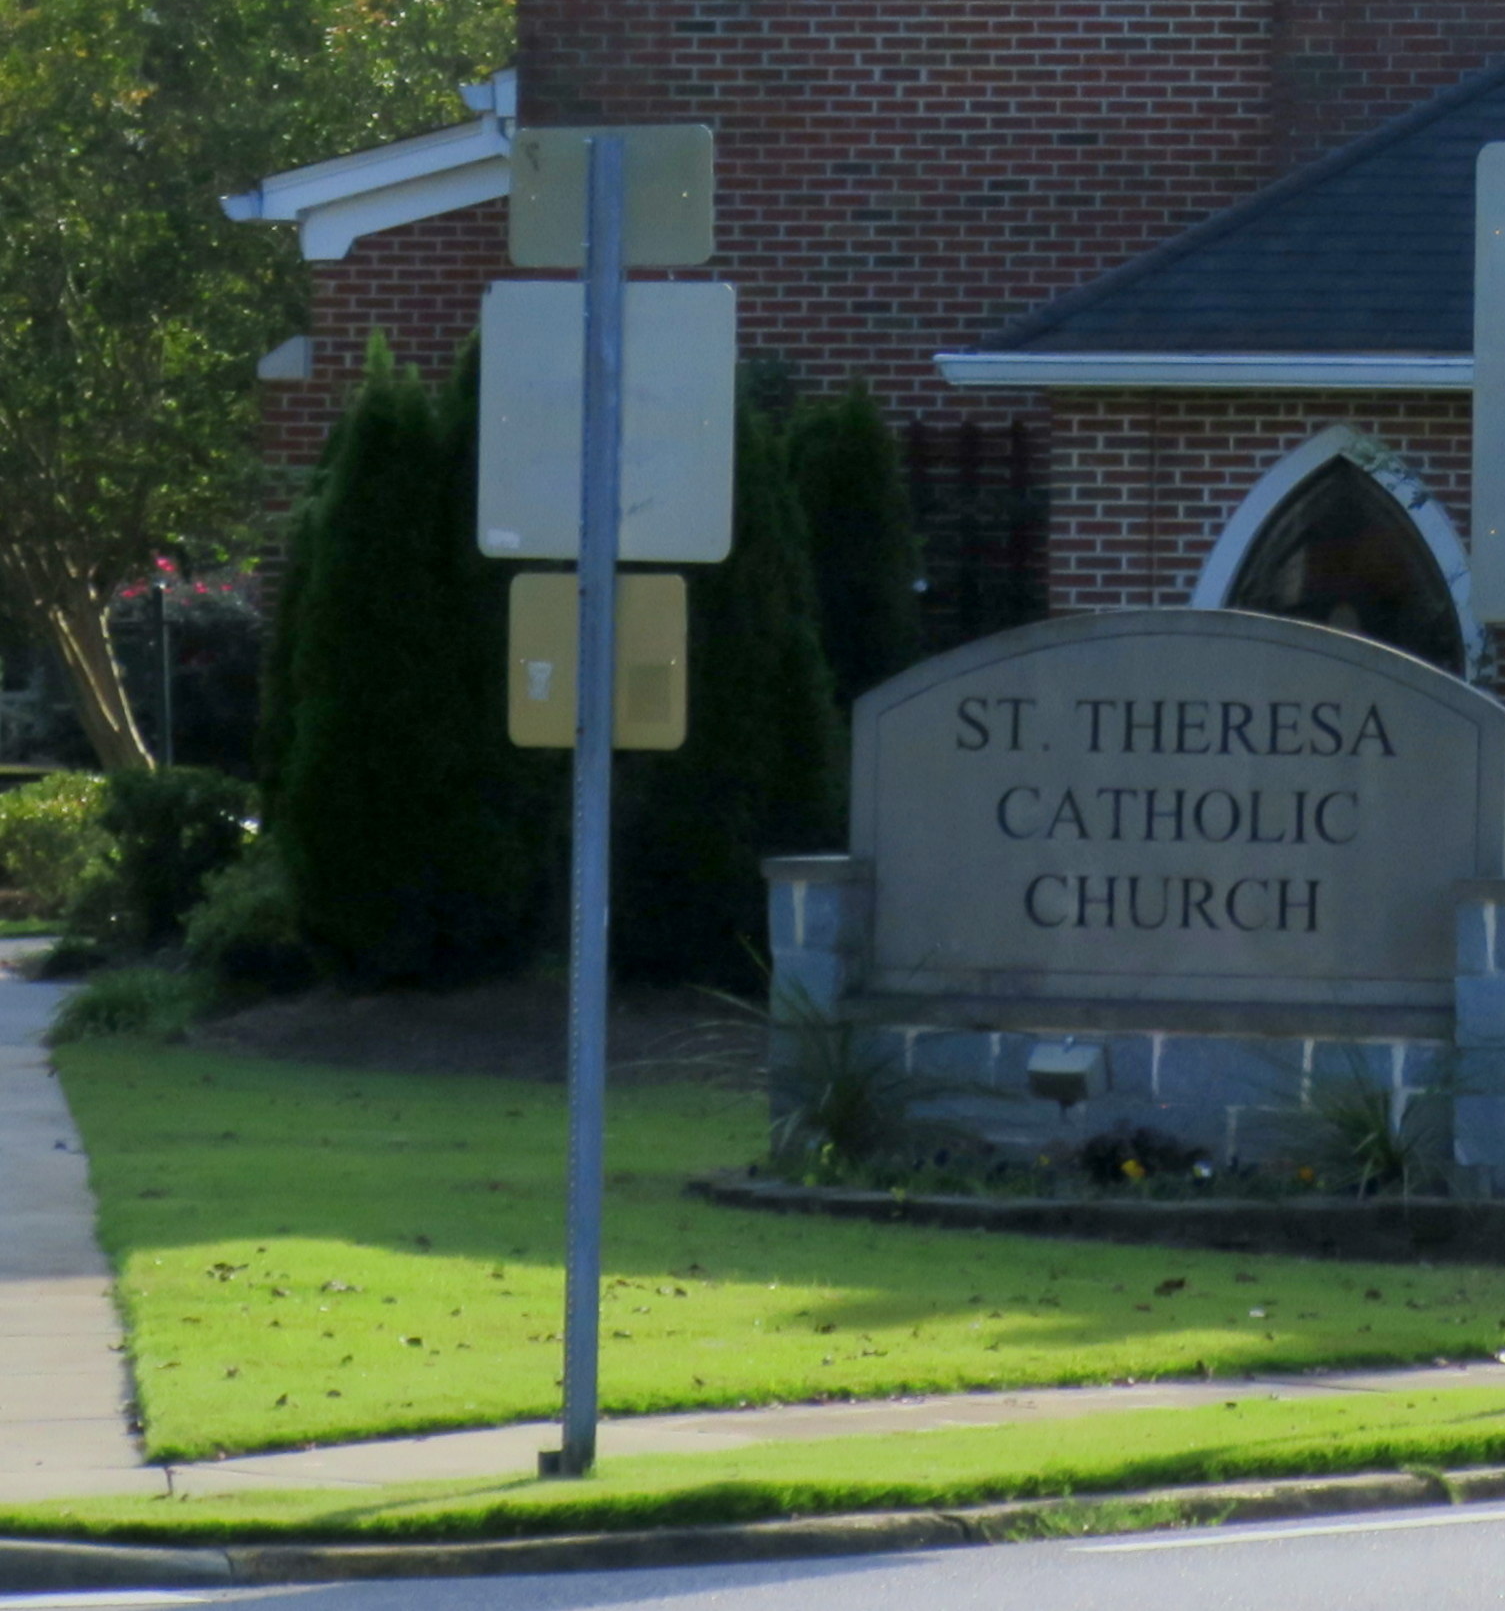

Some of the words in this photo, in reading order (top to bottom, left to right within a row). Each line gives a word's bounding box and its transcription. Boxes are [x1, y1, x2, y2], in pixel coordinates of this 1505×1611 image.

[955, 695, 1052, 754] ST.
[1075, 697, 1397, 758] THERESA
[995, 785, 1361, 846] CATHOLIC
[1024, 872, 1321, 935] CHURCH
